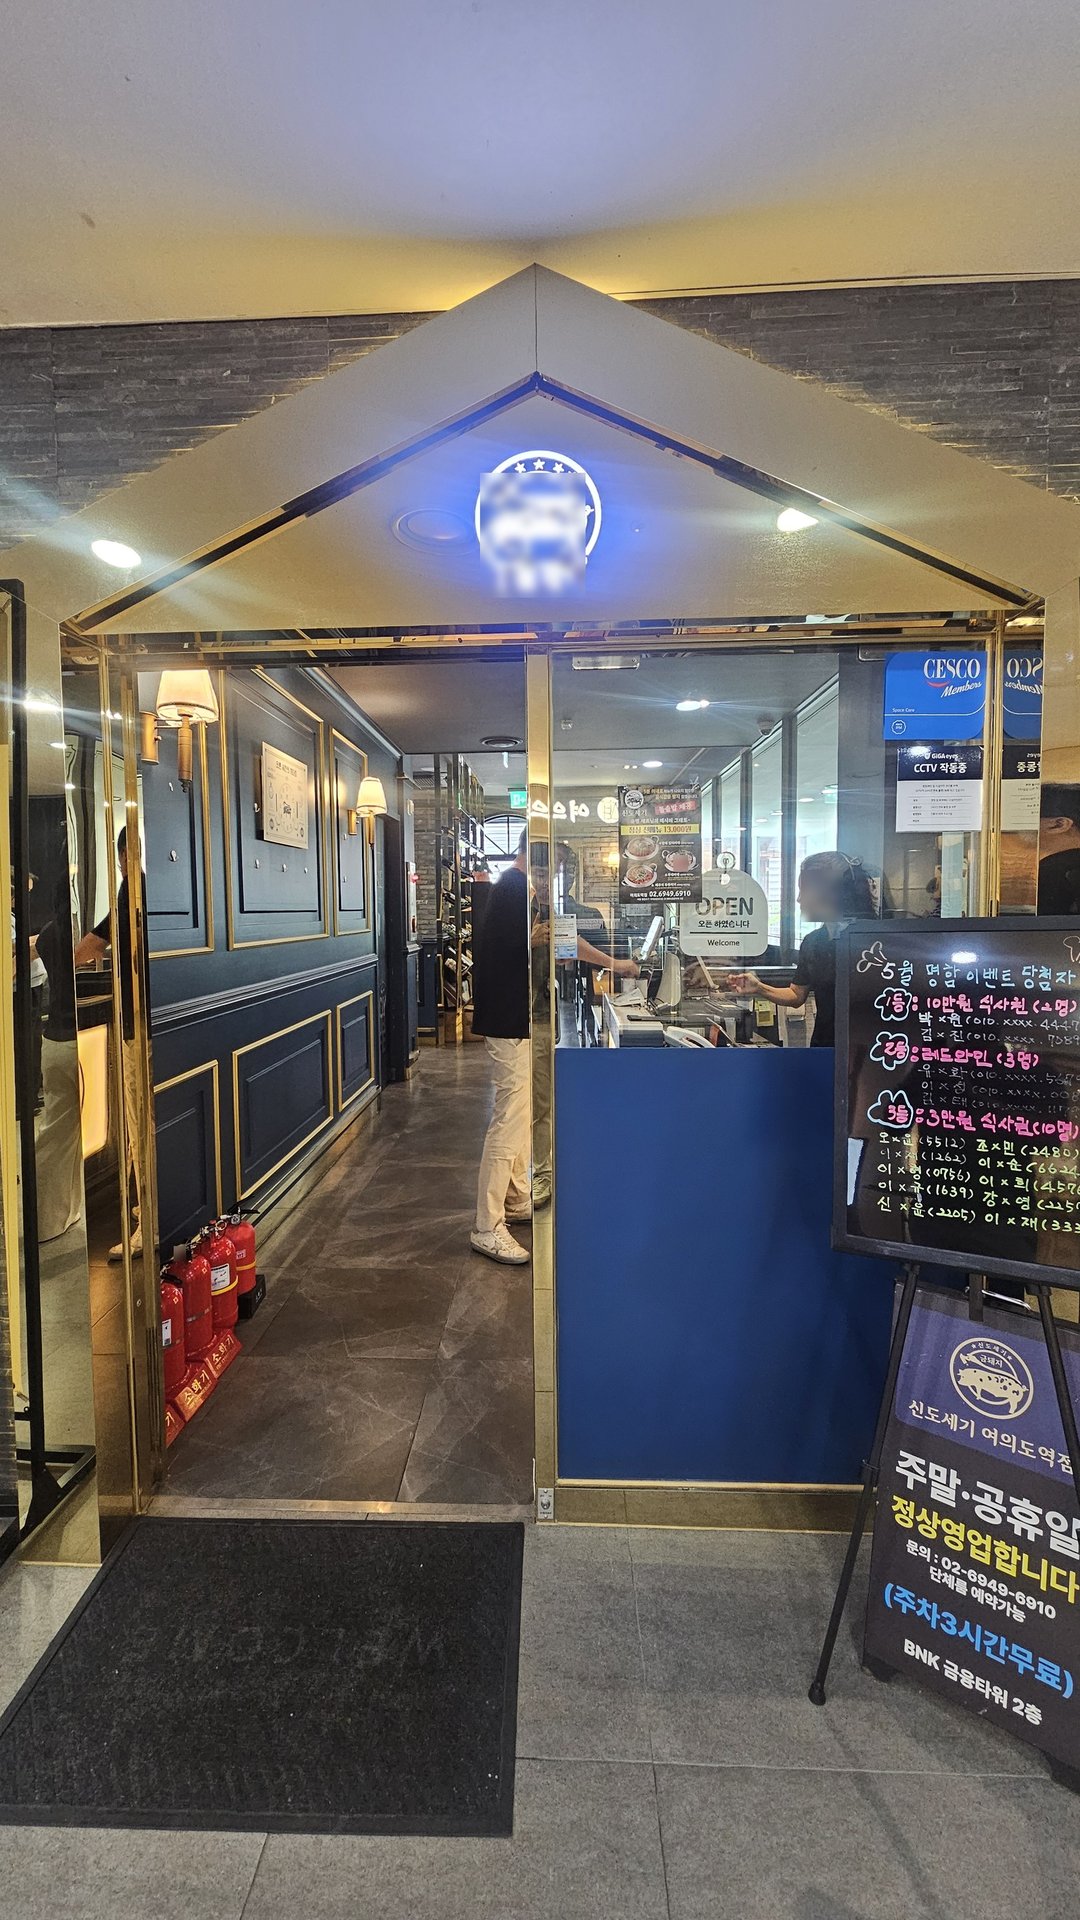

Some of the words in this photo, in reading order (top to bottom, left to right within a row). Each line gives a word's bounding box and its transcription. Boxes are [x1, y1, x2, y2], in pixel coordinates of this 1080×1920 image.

[924, 658, 981, 679] CESCO
[941, 680, 982, 698] Members
[914, 763, 937, 773] CCTV
[939, 762, 967, 774] 작동중
[649, 890, 691, 898] 02.6949.6910
[695, 897, 754, 916] OPEN
[698, 920, 713, 928] 오픈
[714, 920, 750, 928] 하였습니다
[707, 939, 740, 947] Welcome
[881, 959, 913, 986] 5월
[926, 963, 960, 988] 명함
[966, 966, 1015, 989] 이벤트
[1022, 965, 1076, 991] 당첨자
[927, 993, 973, 1013] 10만원
[996, 1051, 1039, 1070] (3명)
[212, 1334, 234, 1365] 소화기
[978, 1342, 1007, 1356] 신도세기
[980, 1353, 1003, 1368] 금돼지
[184, 1369, 210, 1405] 소화기
[909, 1400, 976, 1438] 신도세기
[981, 1427, 1074, 1476] 여의도역점
[891, 1495, 1080, 1604] 정상영업합니다
[905, 1539, 931, 1563] 문의
[941, 1555, 1056, 1620] 02-6949-6910
[970, 1586, 1026, 1623] 예약가능
[884, 1582, 1074, 1699] (주차3시간무료)
[903, 1638, 941, 1671] BNK
[943, 1659, 1008, 1709] 금융타워
[1012, 1697, 1043, 1726] 2층
